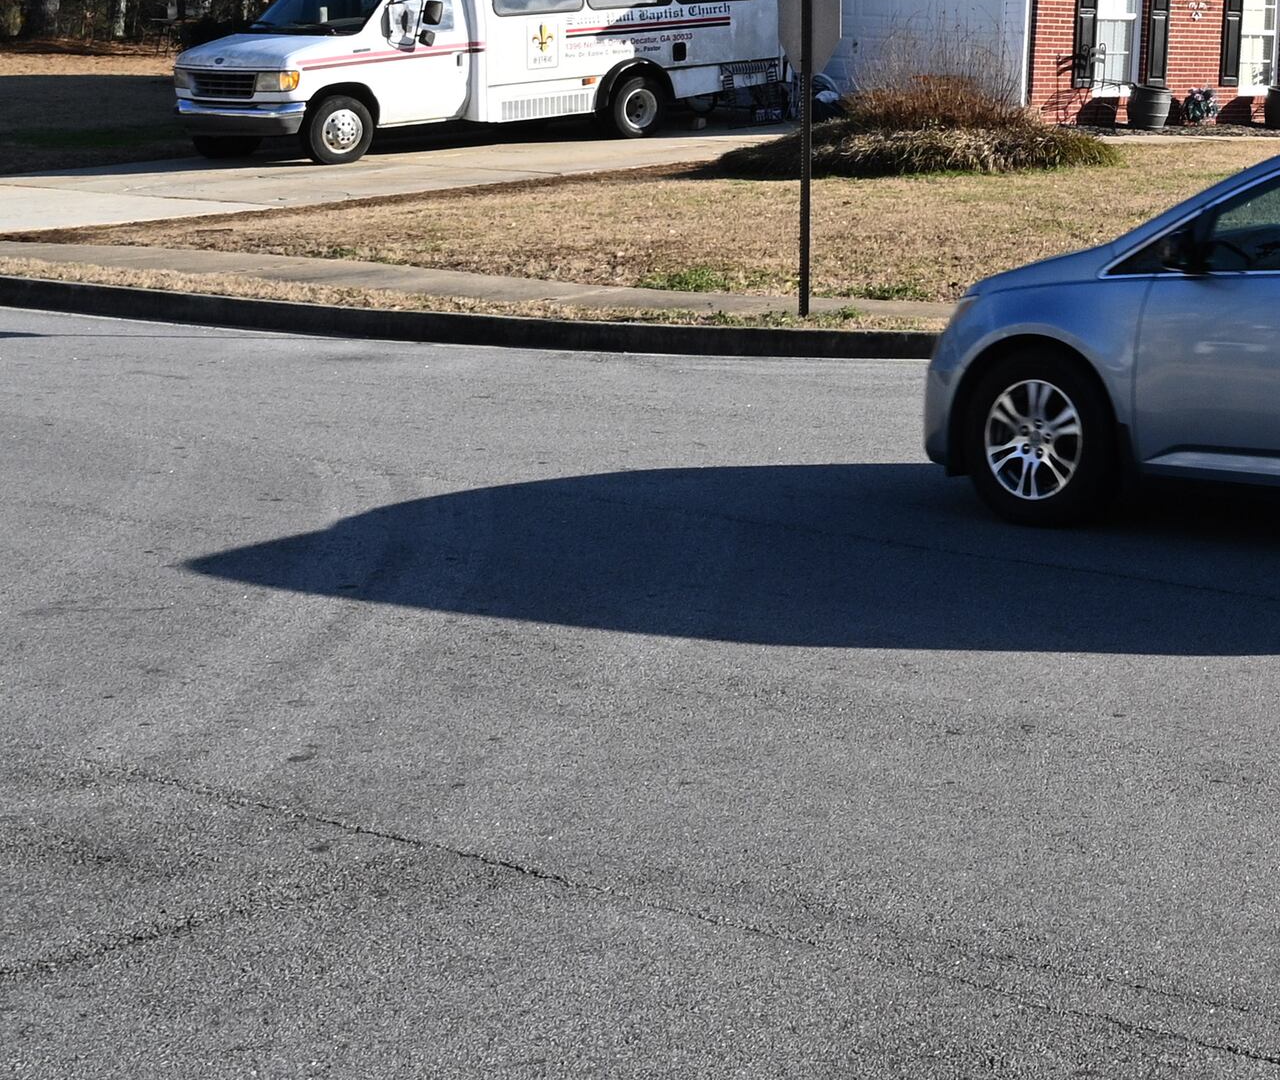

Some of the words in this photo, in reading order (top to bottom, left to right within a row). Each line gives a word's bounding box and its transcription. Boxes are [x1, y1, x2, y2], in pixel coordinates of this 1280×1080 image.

[639, 7, 684, 22] Baptist
[688, 2, 731, 18] Church
[630, 36, 658, 45] Decatur,
[660, 34, 671, 42] GA
